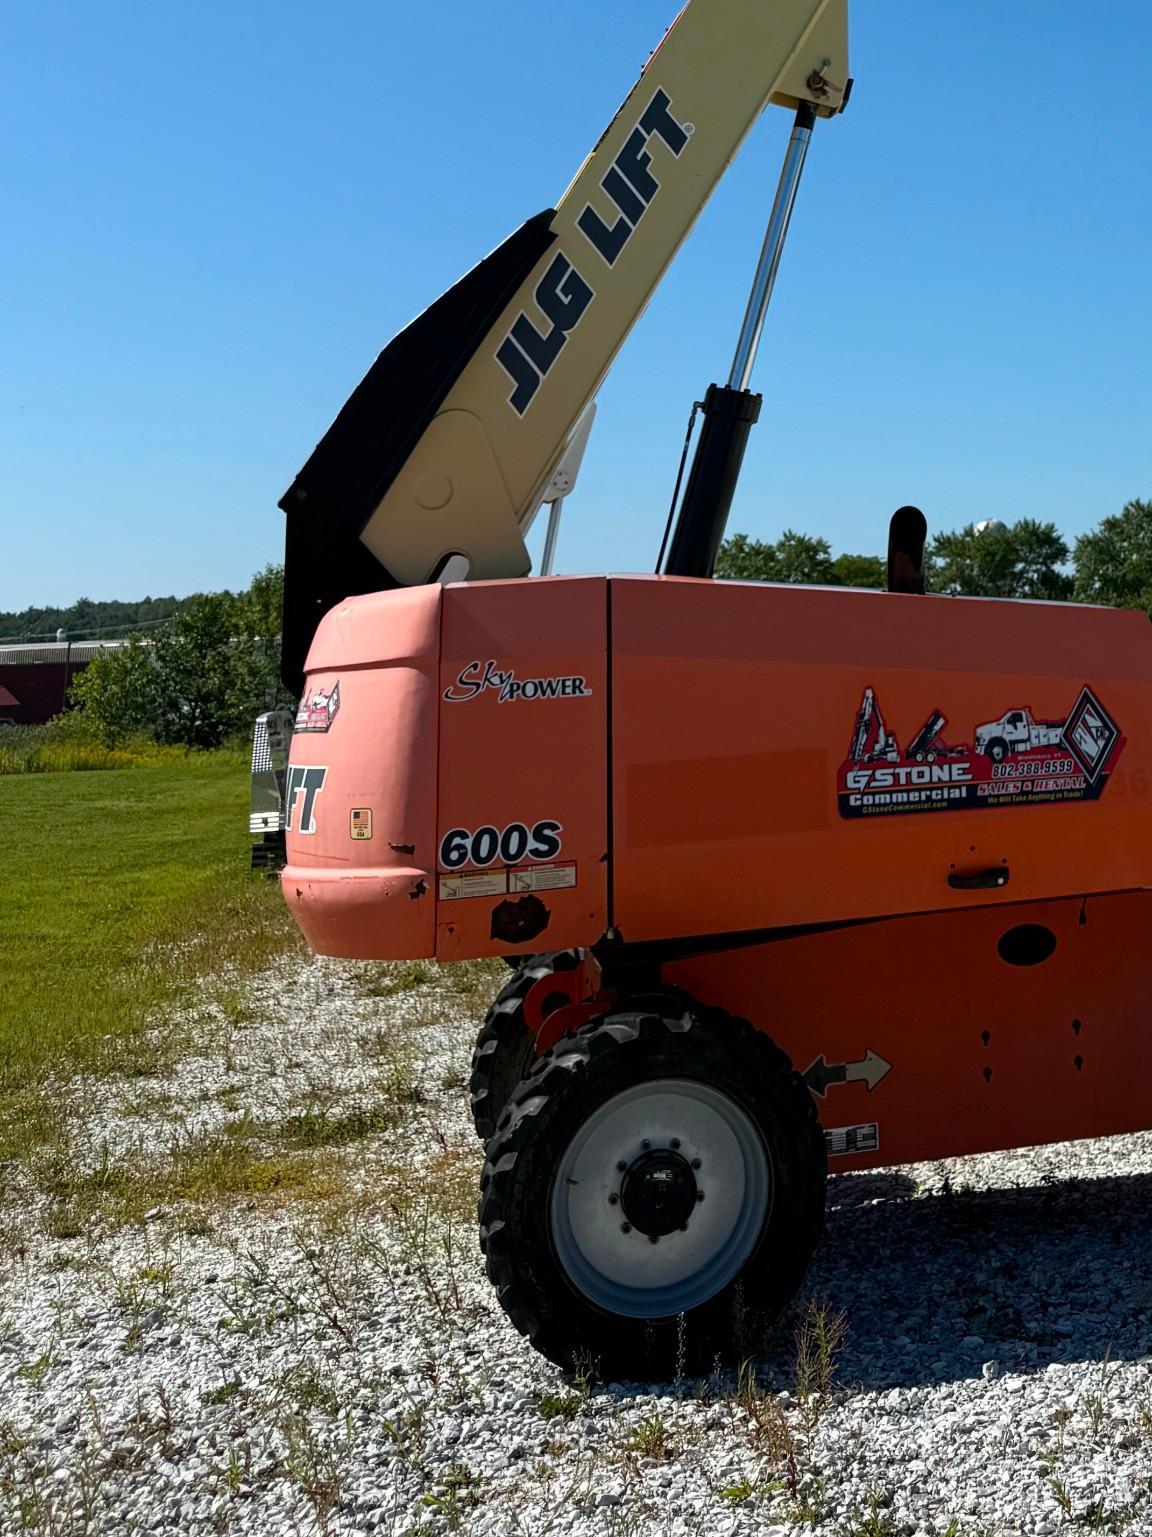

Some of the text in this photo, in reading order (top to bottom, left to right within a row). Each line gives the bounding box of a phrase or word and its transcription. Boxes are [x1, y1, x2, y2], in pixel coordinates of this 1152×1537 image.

[494, 84, 690, 419] JLG LIFT
[991, 758, 1074, 779] 802.388.9599
[849, 785, 967, 806] Commercial
[977, 780, 1022, 796] SALES
[1033, 776, 1087, 793] RENTAL
[1028, 792, 1055, 803] Anything
[440, 819, 563, 869] 600S
